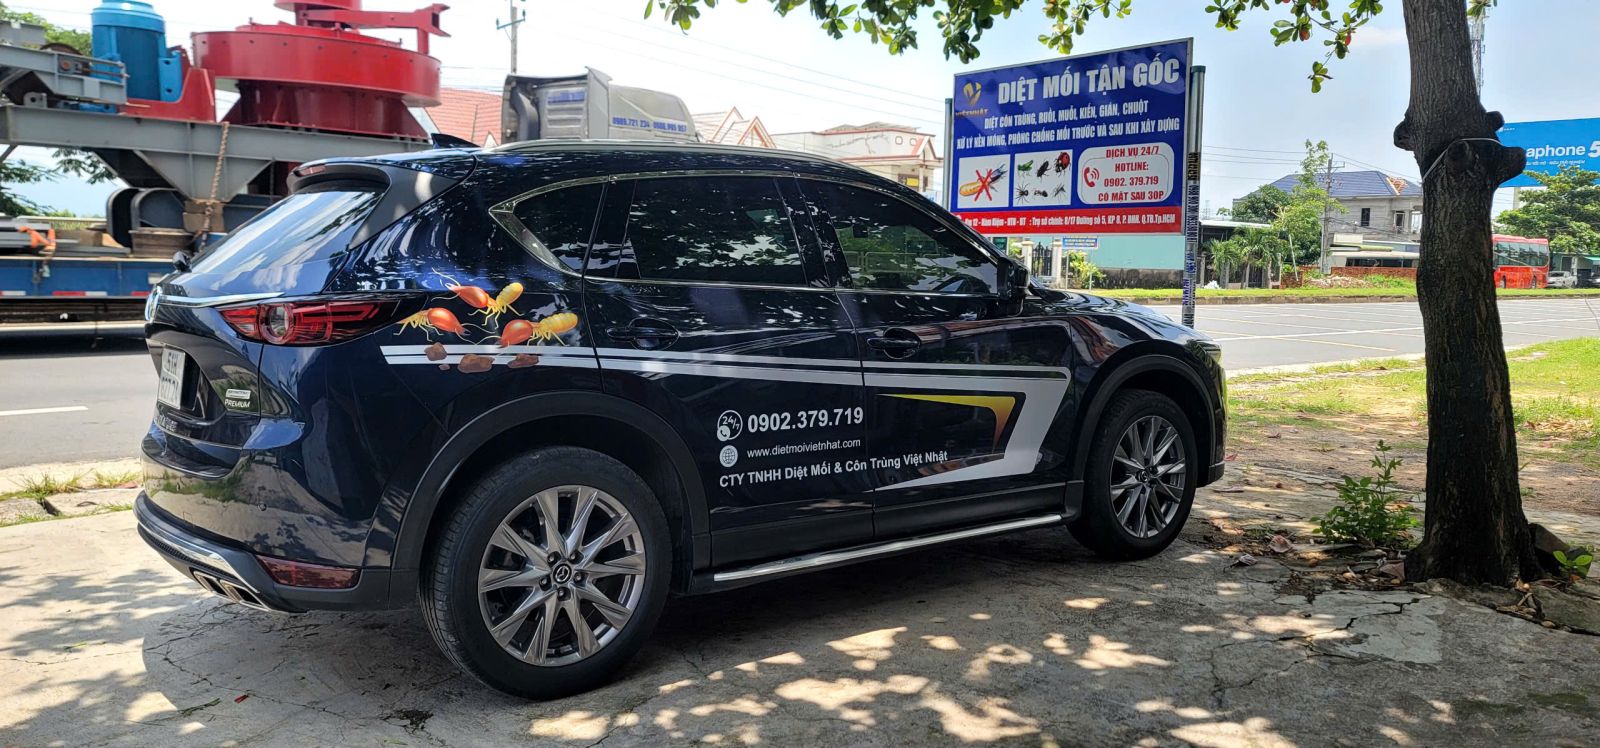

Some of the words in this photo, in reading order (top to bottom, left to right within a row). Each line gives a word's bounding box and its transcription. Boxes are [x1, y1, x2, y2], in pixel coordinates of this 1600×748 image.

[998, 76, 1038, 106] DIỆT
[1043, 65, 1081, 99] MỐI
[1086, 64, 1126, 96] TẬN
[1133, 52, 1180, 88] GỐC
[984, 115, 999, 131] DIỆT
[999, 114, 1013, 128] CÔN
[1079, 102, 1097, 120] KIẾN,
[1099, 101, 1120, 117] GIÁN,
[1122, 98, 1149, 116] CHUỘT
[966, 135, 973, 149] LÝ
[1007, 131, 1030, 145] PHÒNG
[1031, 127, 1055, 143] CHỐNG
[1056, 125, 1071, 140] MỐI
[1072, 124, 1096, 140] TRƯỚC
[1097, 123, 1107, 137] VÀ
[1108, 123, 1123, 136] SAU
[1125, 121, 1139, 135] KHI
[1140, 118, 1156, 134] XÂY
[1157, 116, 1180, 134] DỰNG
[1106, 148, 1126, 160] DỊCH
[1127, 147, 1139, 158] VỤ
[1140, 146, 1160, 156] 24/7
[1525, 144, 1586, 160] aphone
[1114, 161, 1149, 172] HOTLINE:
[1104, 177, 1127, 187] 0902.
[1129, 175, 1159, 186] 379.719
[1098, 191, 1109, 202] CÓ
[1111, 191, 1129, 203] MẶT
[1130, 191, 1146, 201] SAU
[1148, 190, 1164, 200] 30P
[225, 398, 251, 408] PREMIUM
[722, 415, 740, 430] 24/7
[747, 406, 864, 433] 0902.379.719
[746, 439, 861, 459] www.dietmoivietnhat.com
[719, 474, 744, 488] CTY
[747, 468, 782, 484] TNHH
[784, 465, 808, 480] Diệt
[810, 460, 831, 476] Mối
[834, 461, 843, 473] &
[845, 459, 867, 473] Côn
[869, 456, 901, 469] Trùng
[903, 453, 923, 467] Việt
[925, 450, 948, 463] Nhật
